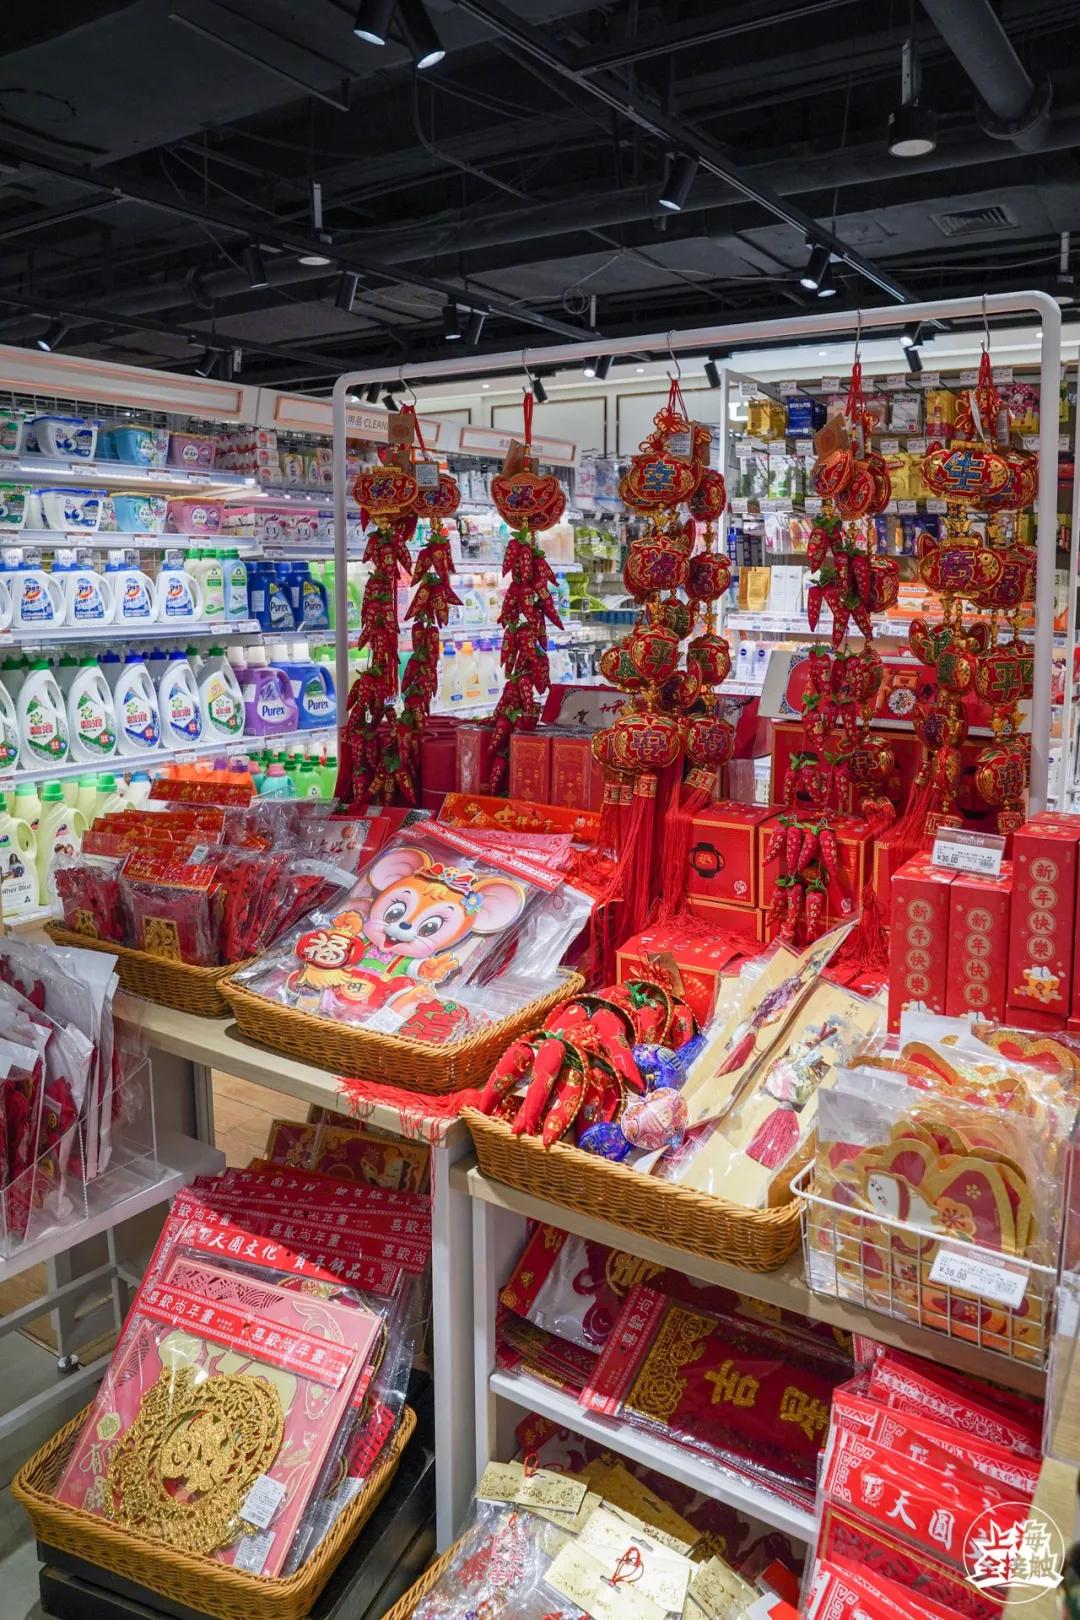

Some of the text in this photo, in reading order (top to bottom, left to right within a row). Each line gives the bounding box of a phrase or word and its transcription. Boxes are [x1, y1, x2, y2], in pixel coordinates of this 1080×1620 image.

[270, 601, 289, 612] Purex
[304, 601, 322, 612] Purex
[262, 704, 285, 717] Purex
[308, 699, 329, 711] Purex
[1032, 864, 1052, 958] 新年快樂
[304, 932, 351, 962] 福
[911, 905, 928, 992] 新年快樂
[969, 911, 988, 1002] 新年快樂
[147, 1291, 215, 1325] 喜歡尚年畫
[251, 1327, 327, 1365] 喜歡尚年畫
[704, 1360, 829, 1441] 吉星
